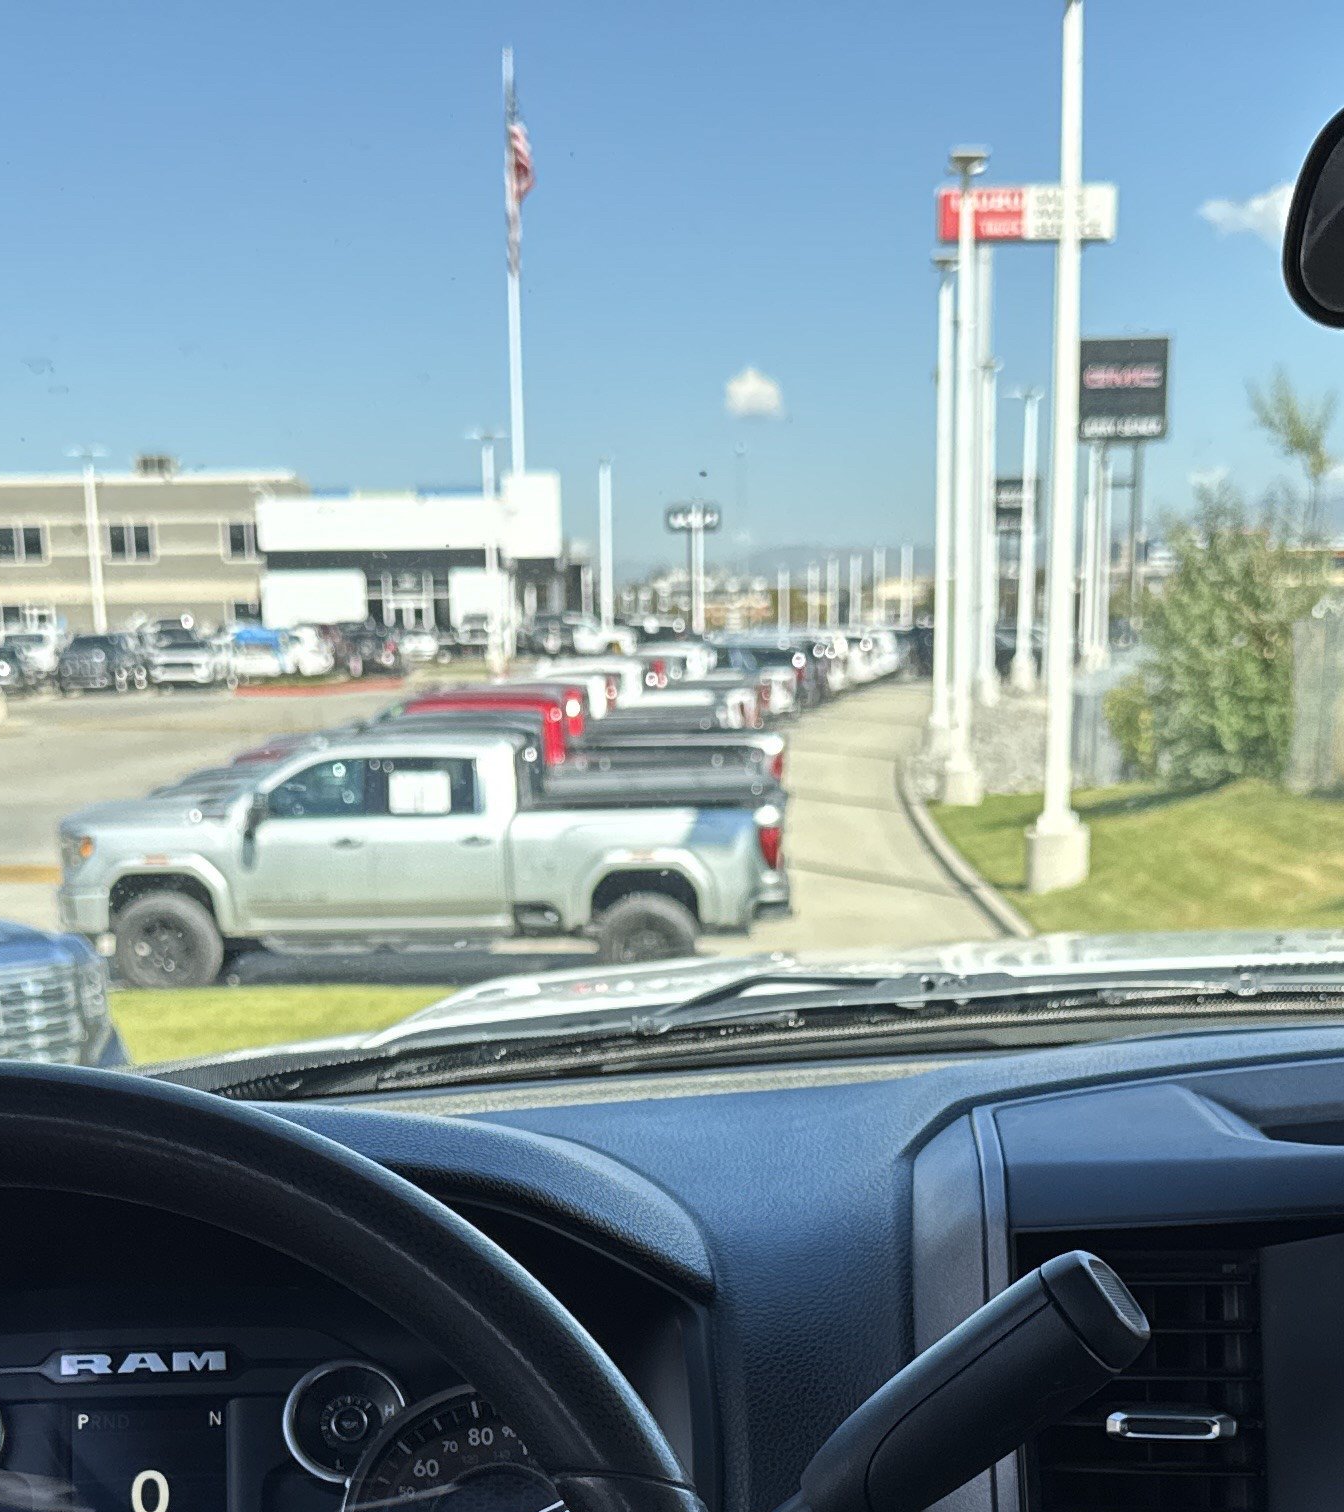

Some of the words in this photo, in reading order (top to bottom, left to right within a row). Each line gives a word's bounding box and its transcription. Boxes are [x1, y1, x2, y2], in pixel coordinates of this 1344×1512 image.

[60, 1351, 226, 1376] RAM
[209, 1411, 222, 1426] N
[467, 1427, 494, 1446] 80
[442, 1441, 458, 1453] 70
[413, 1459, 439, 1477] 60
